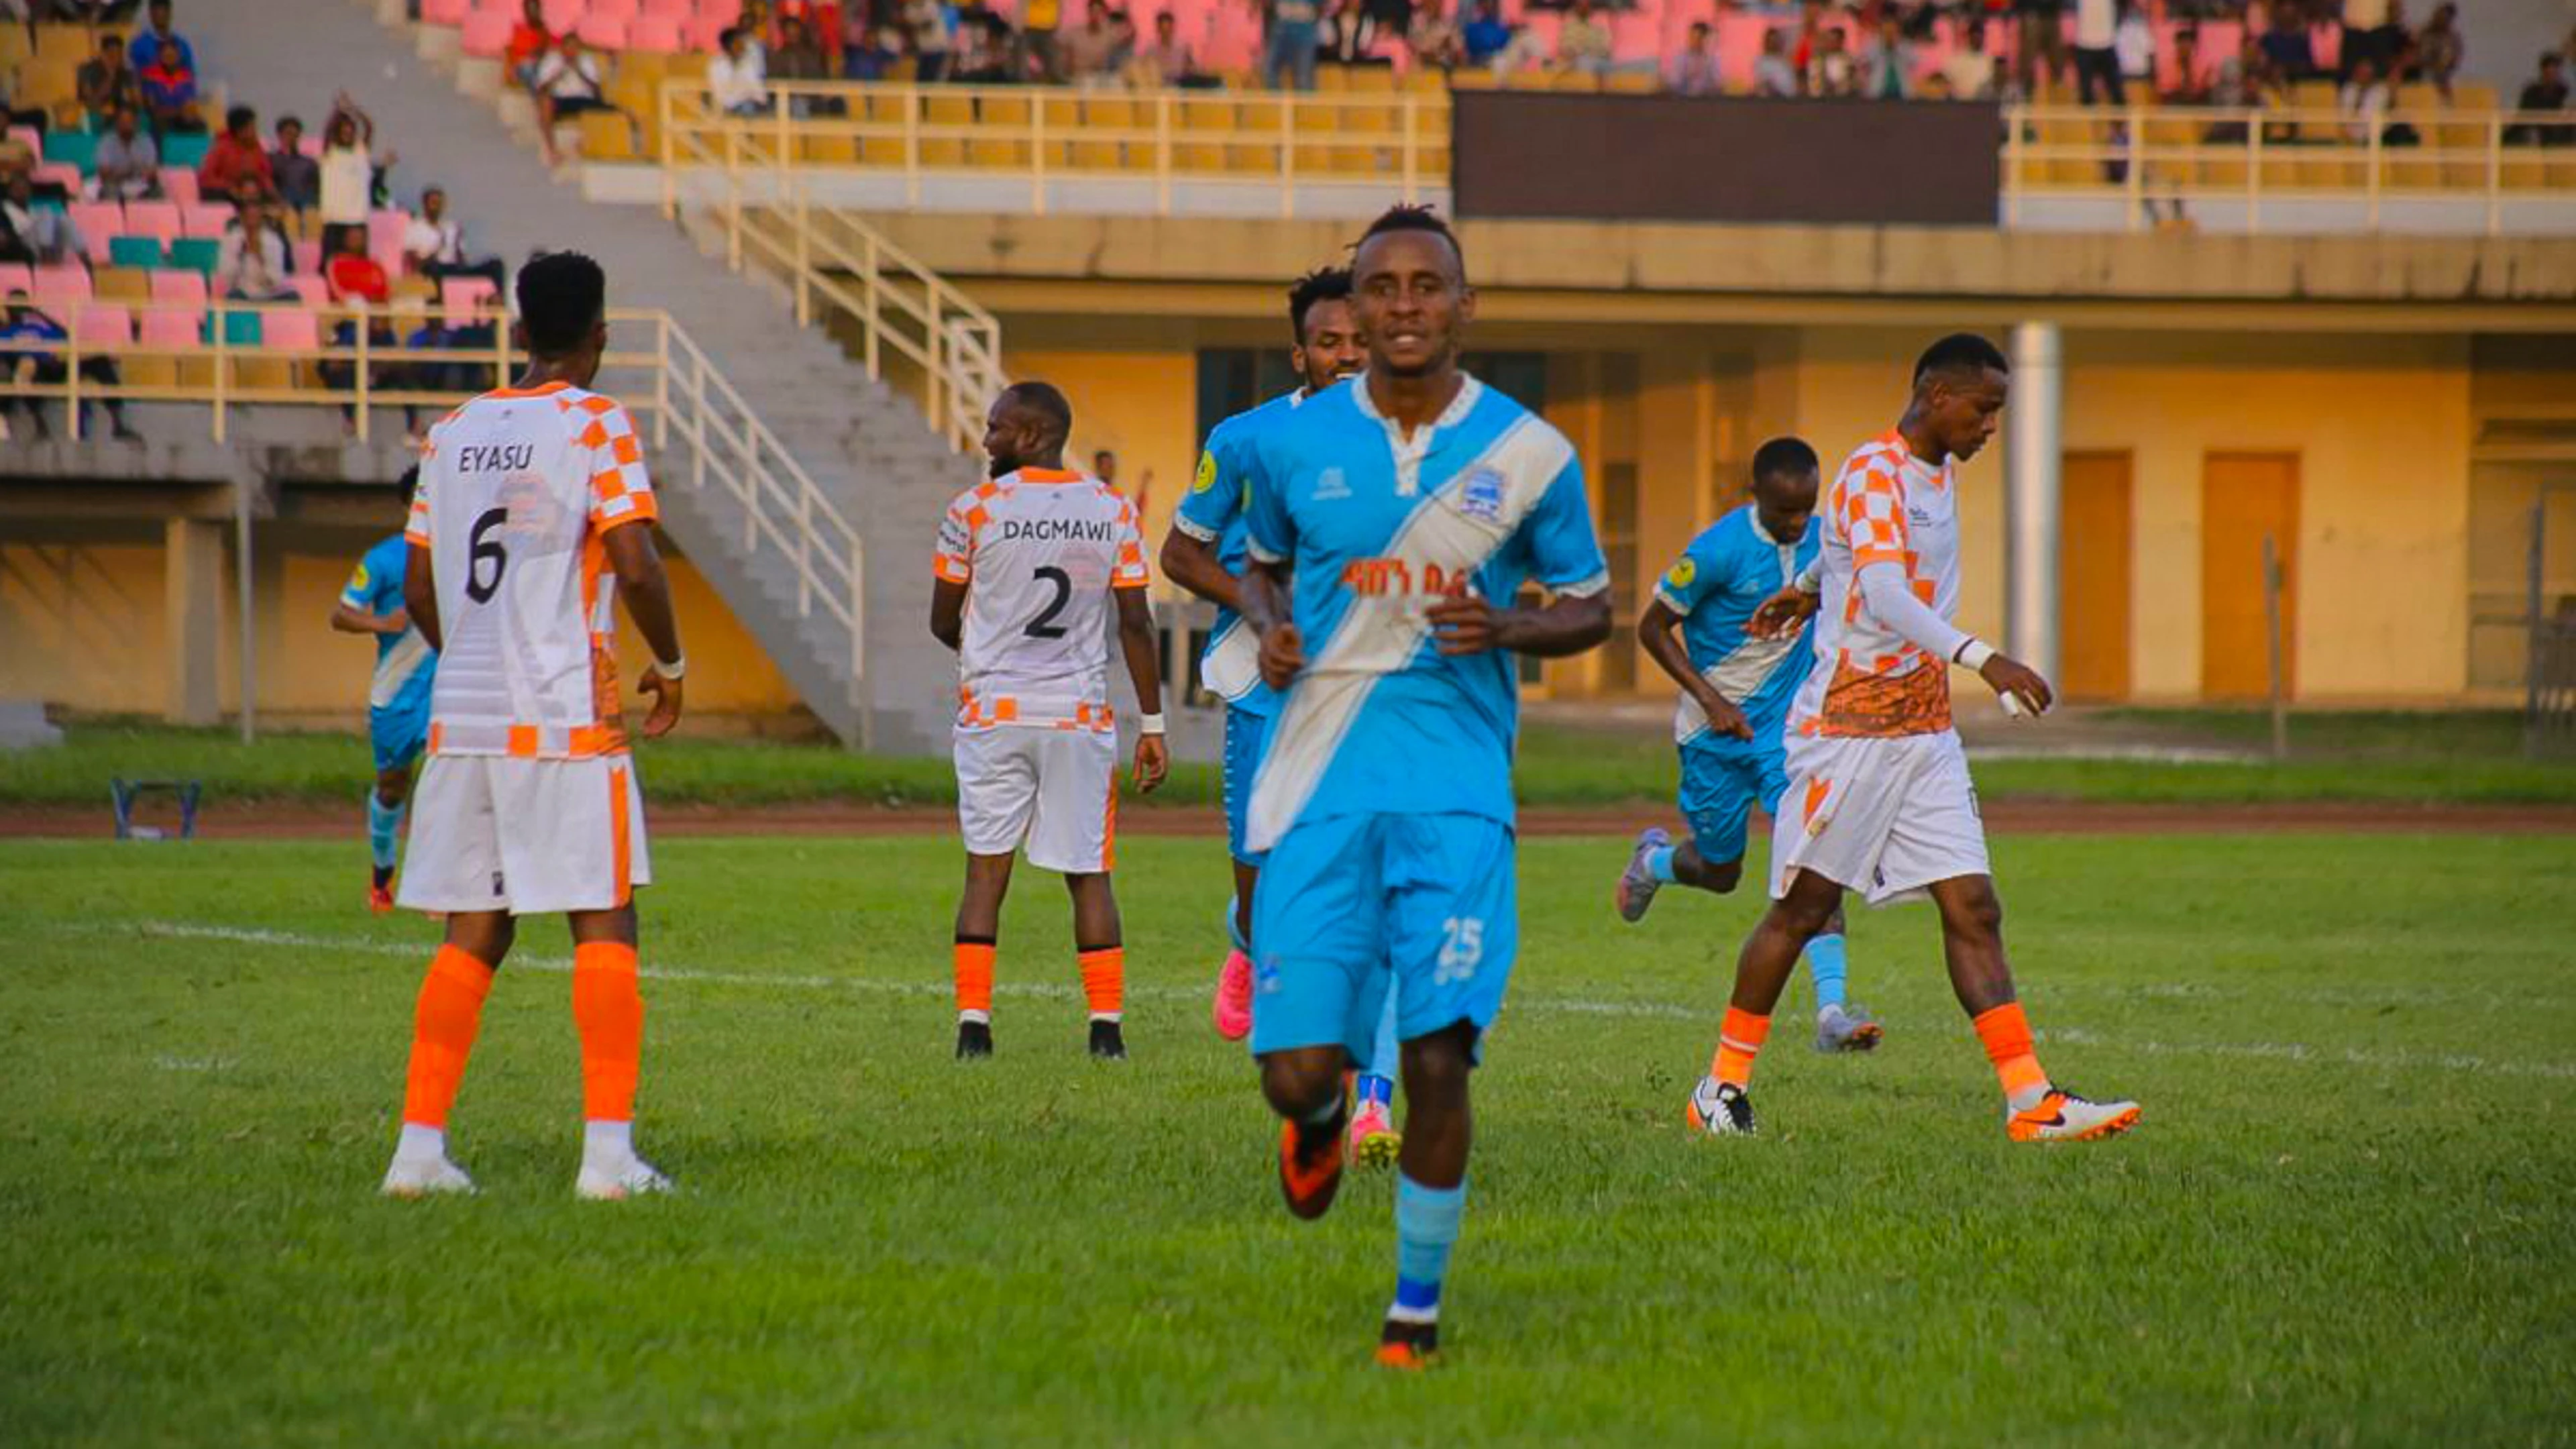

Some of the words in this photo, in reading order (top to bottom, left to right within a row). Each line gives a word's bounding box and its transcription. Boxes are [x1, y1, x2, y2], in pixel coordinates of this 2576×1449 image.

[459, 444, 534, 473] EYASU
[465, 507, 508, 605] 6
[1004, 520, 1113, 541] DAGMAWI
[1023, 566, 1071, 639] 2
[1434, 916, 1484, 983] 25
